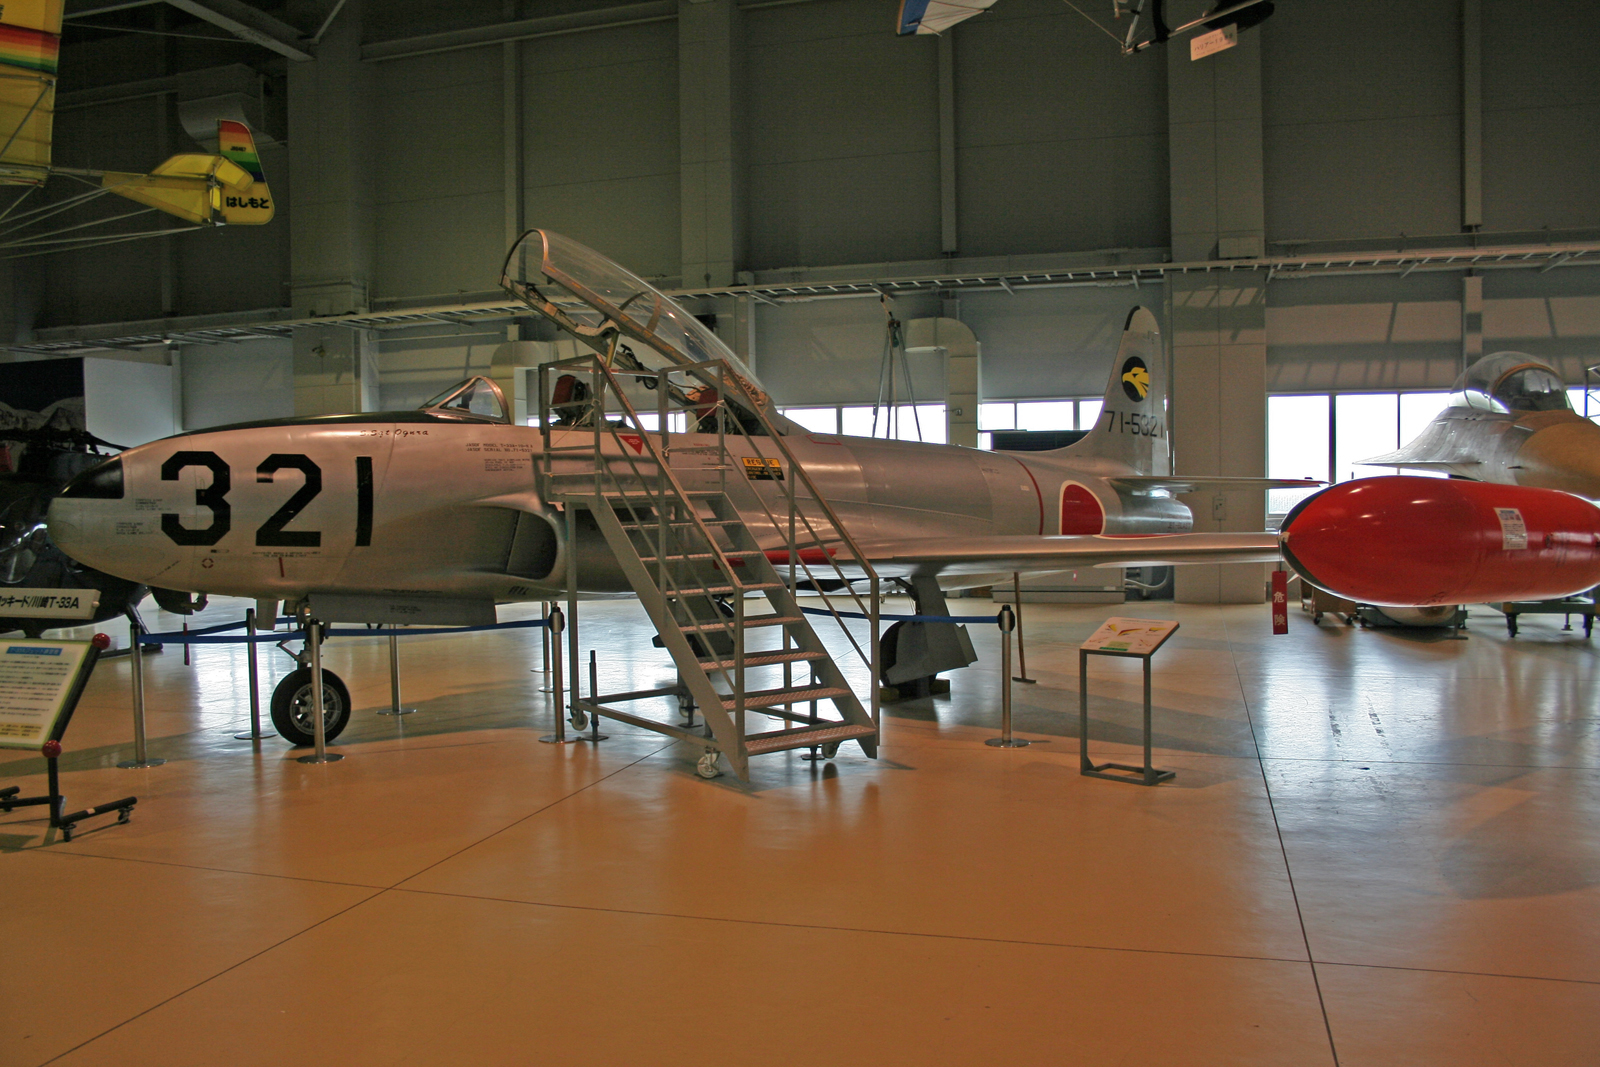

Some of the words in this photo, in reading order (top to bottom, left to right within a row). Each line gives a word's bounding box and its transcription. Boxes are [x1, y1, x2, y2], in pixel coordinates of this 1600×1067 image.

[226, 196, 270, 209] はしもと
[1104, 410, 1164, 439] 71-5321
[161, 451, 373, 547] 321
[0, 595, 79, 609] ッキード/川崎T-33A
[1273, 591, 1286, 627] 危険
